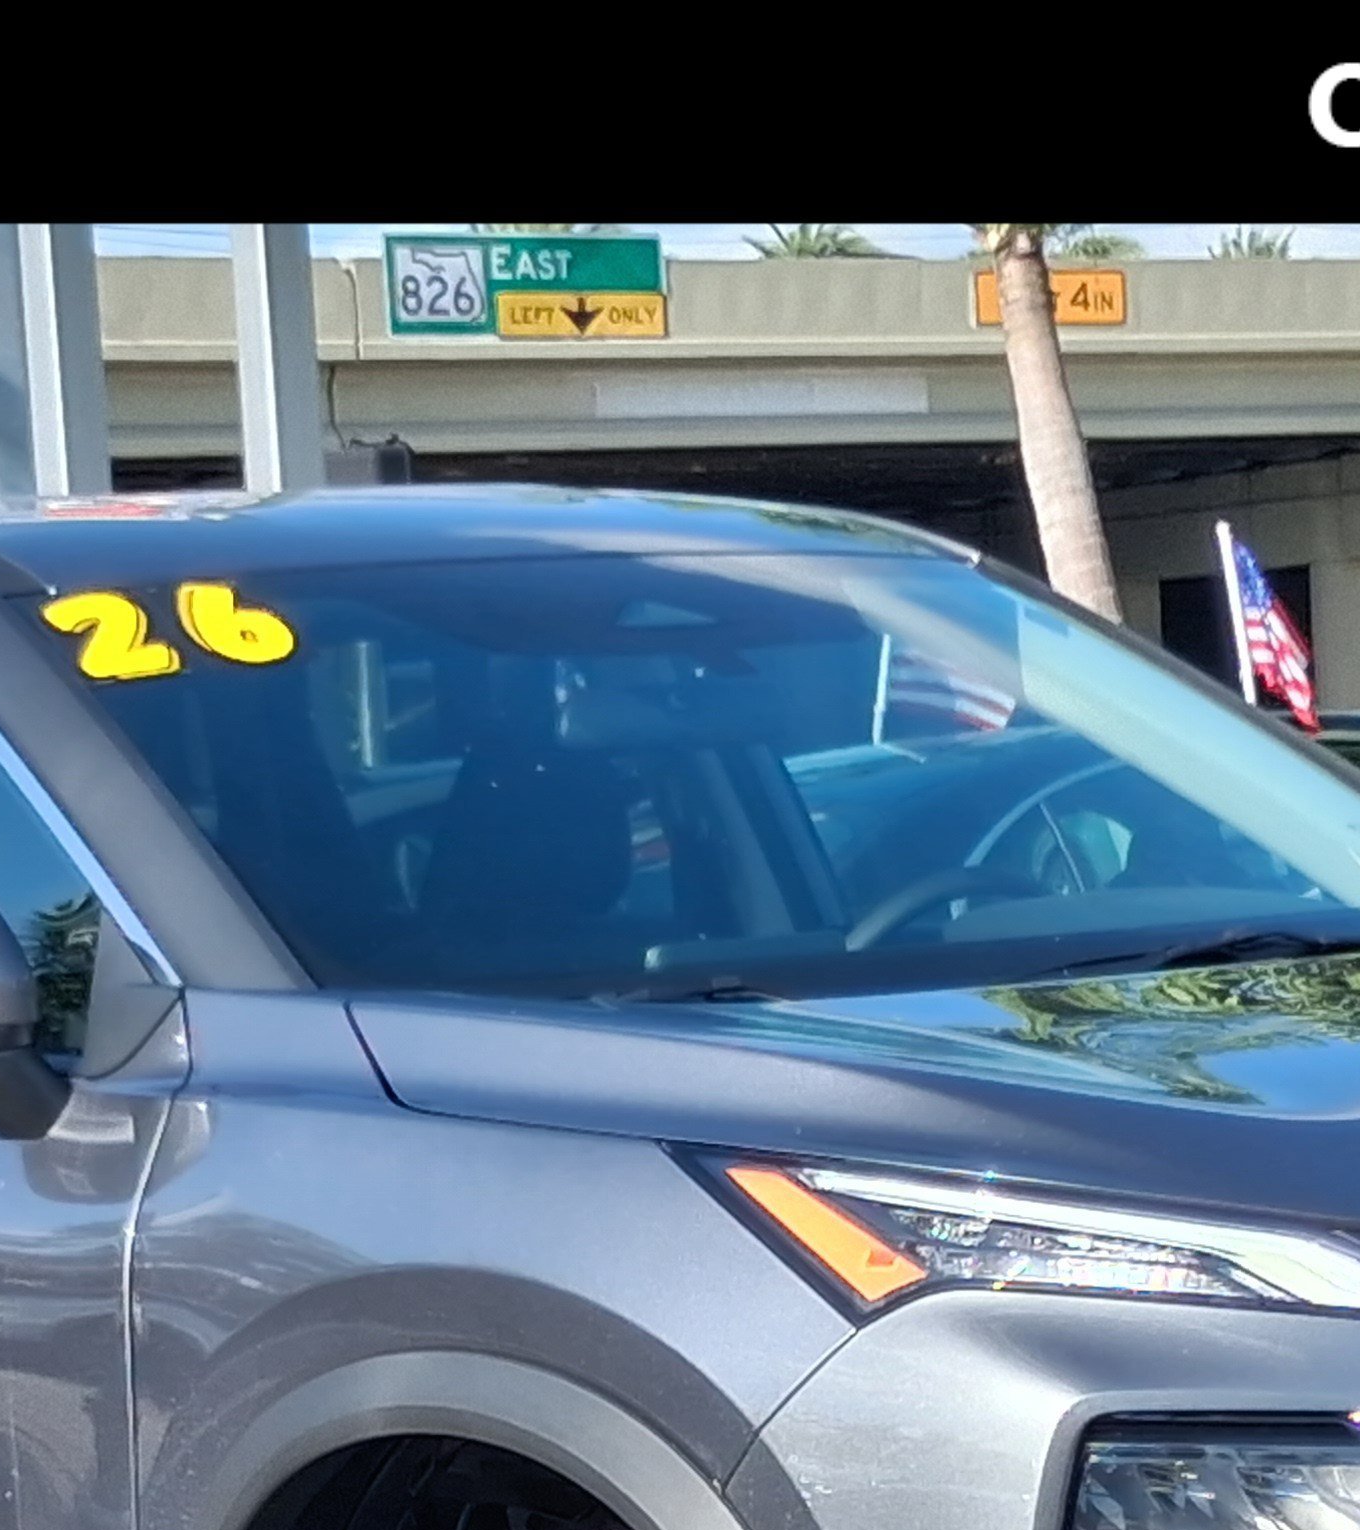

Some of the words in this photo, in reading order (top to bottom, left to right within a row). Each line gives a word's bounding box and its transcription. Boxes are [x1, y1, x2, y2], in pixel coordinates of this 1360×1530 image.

[490, 243, 573, 281] EAST
[401, 274, 475, 317] 826
[509, 306, 556, 326] LEFT
[608, 306, 658, 326] ONLY
[39, 577, 296, 683] 26
